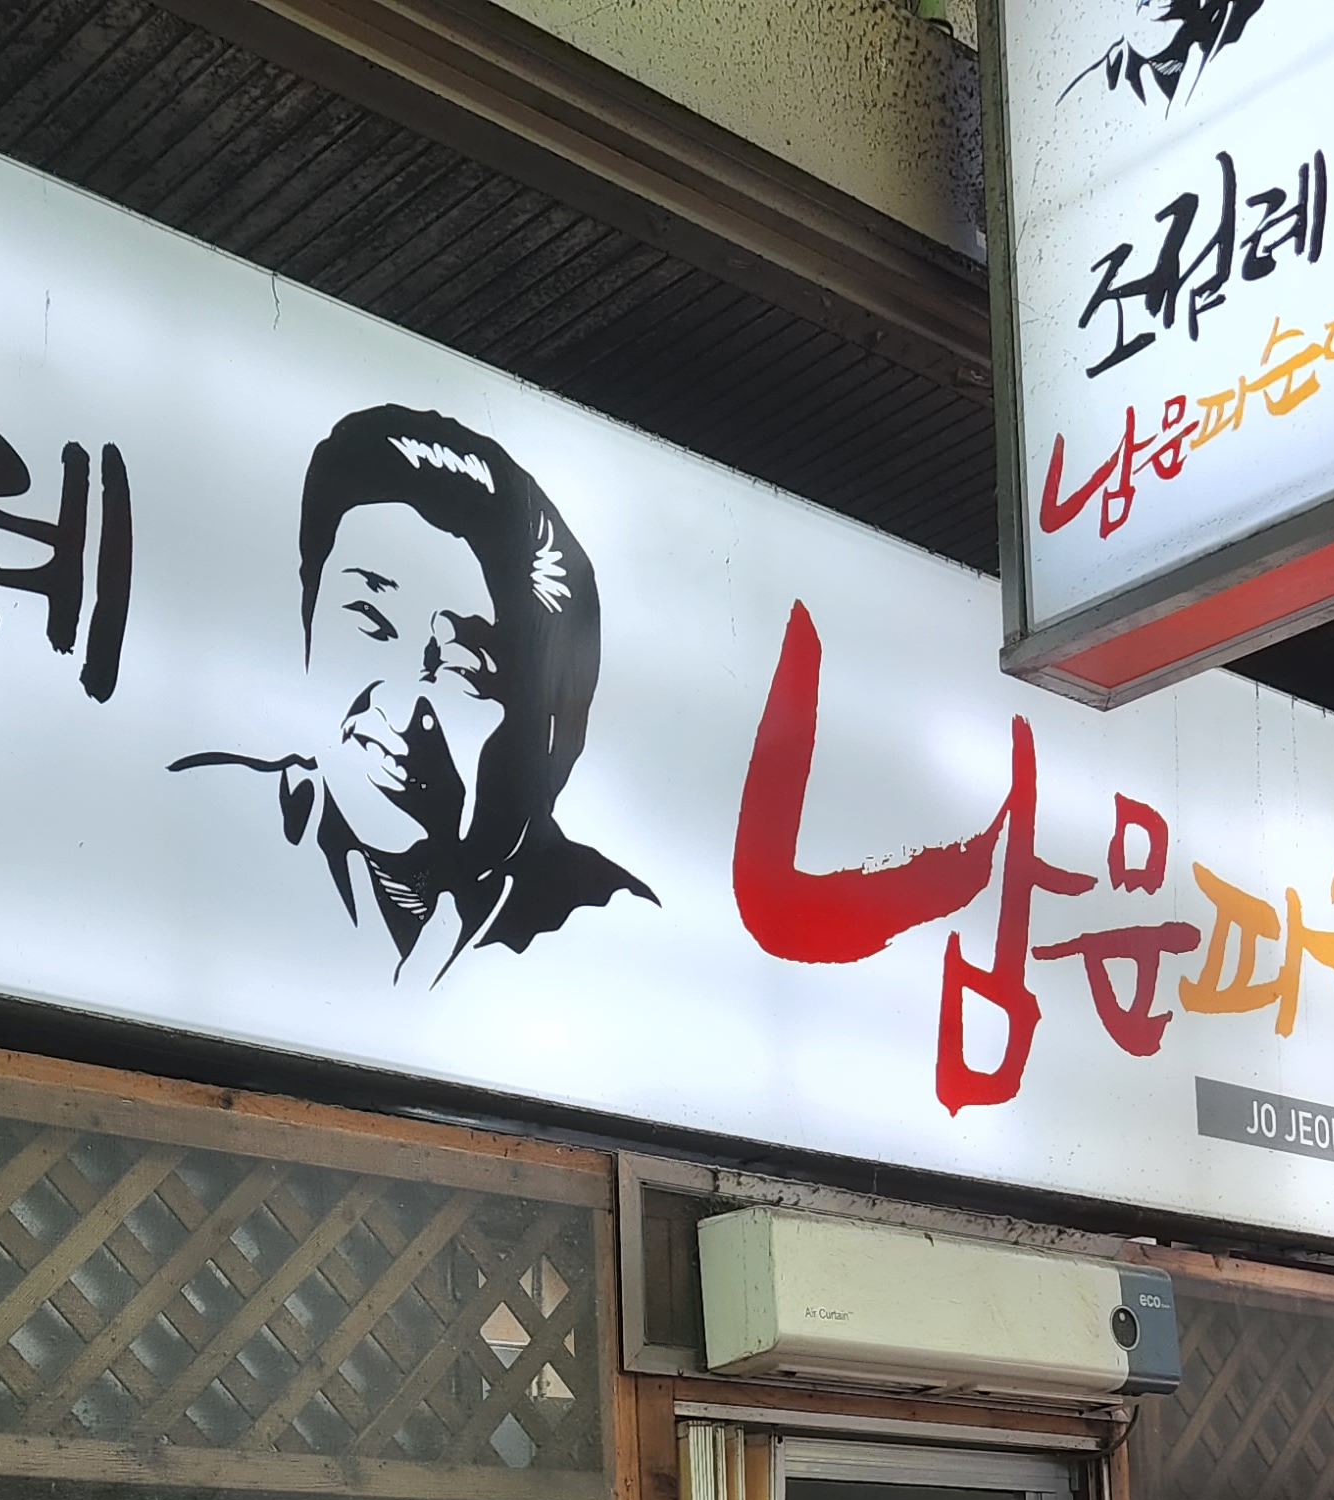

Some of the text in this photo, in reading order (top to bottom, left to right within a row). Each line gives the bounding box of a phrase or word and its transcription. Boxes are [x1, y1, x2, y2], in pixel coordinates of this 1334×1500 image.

[1078, 149, 1327, 378] 조점례
[1246, 1101, 1277, 1138] JO
[805, 1307, 849, 1320] Air Curtain
[1140, 1294, 1160, 1308] eco
